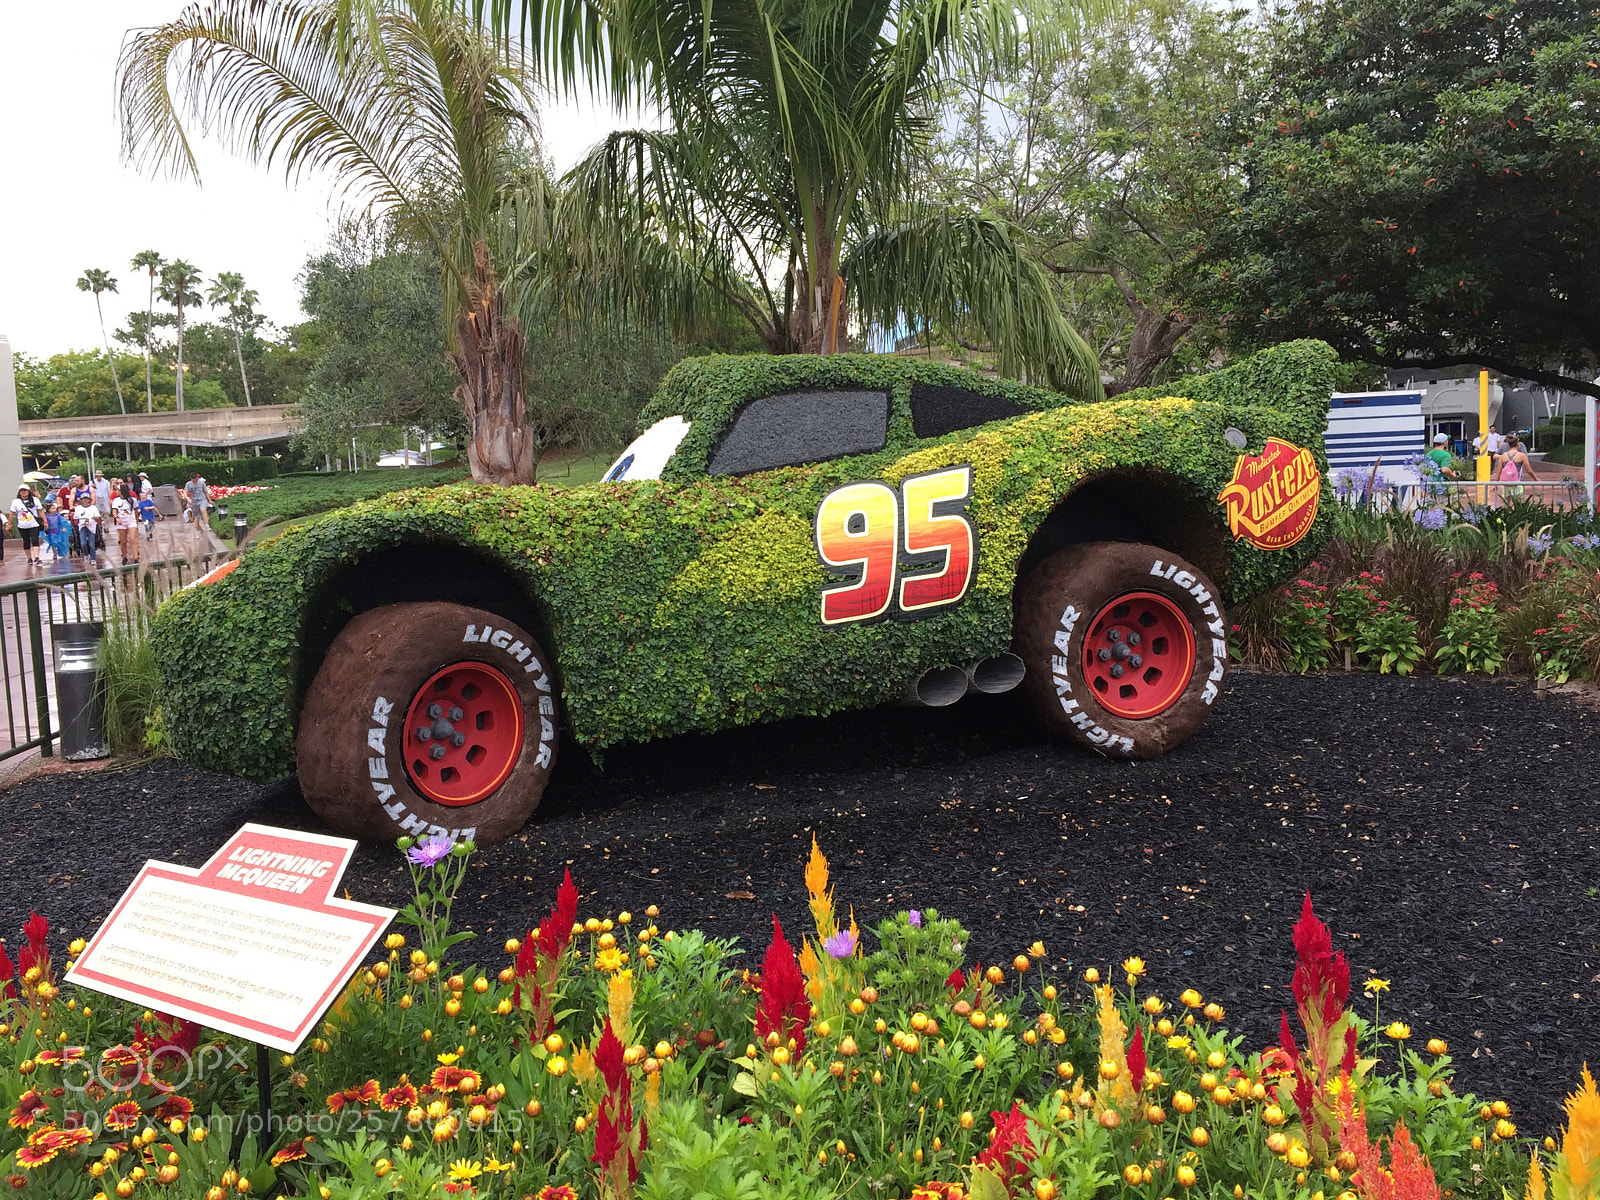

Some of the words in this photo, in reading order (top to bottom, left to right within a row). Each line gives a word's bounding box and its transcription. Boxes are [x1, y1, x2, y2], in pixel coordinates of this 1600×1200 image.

[1245, 444, 1281, 478] Medicated
[815, 466, 975, 626] 95
[463, 624, 555, 769] LIGHTYEAR
[1051, 605, 1135, 753] LIGHTYEAR
[1150, 560, 1227, 705] LIGHTYEAR
[228, 845, 334, 879] LIGHTNING
